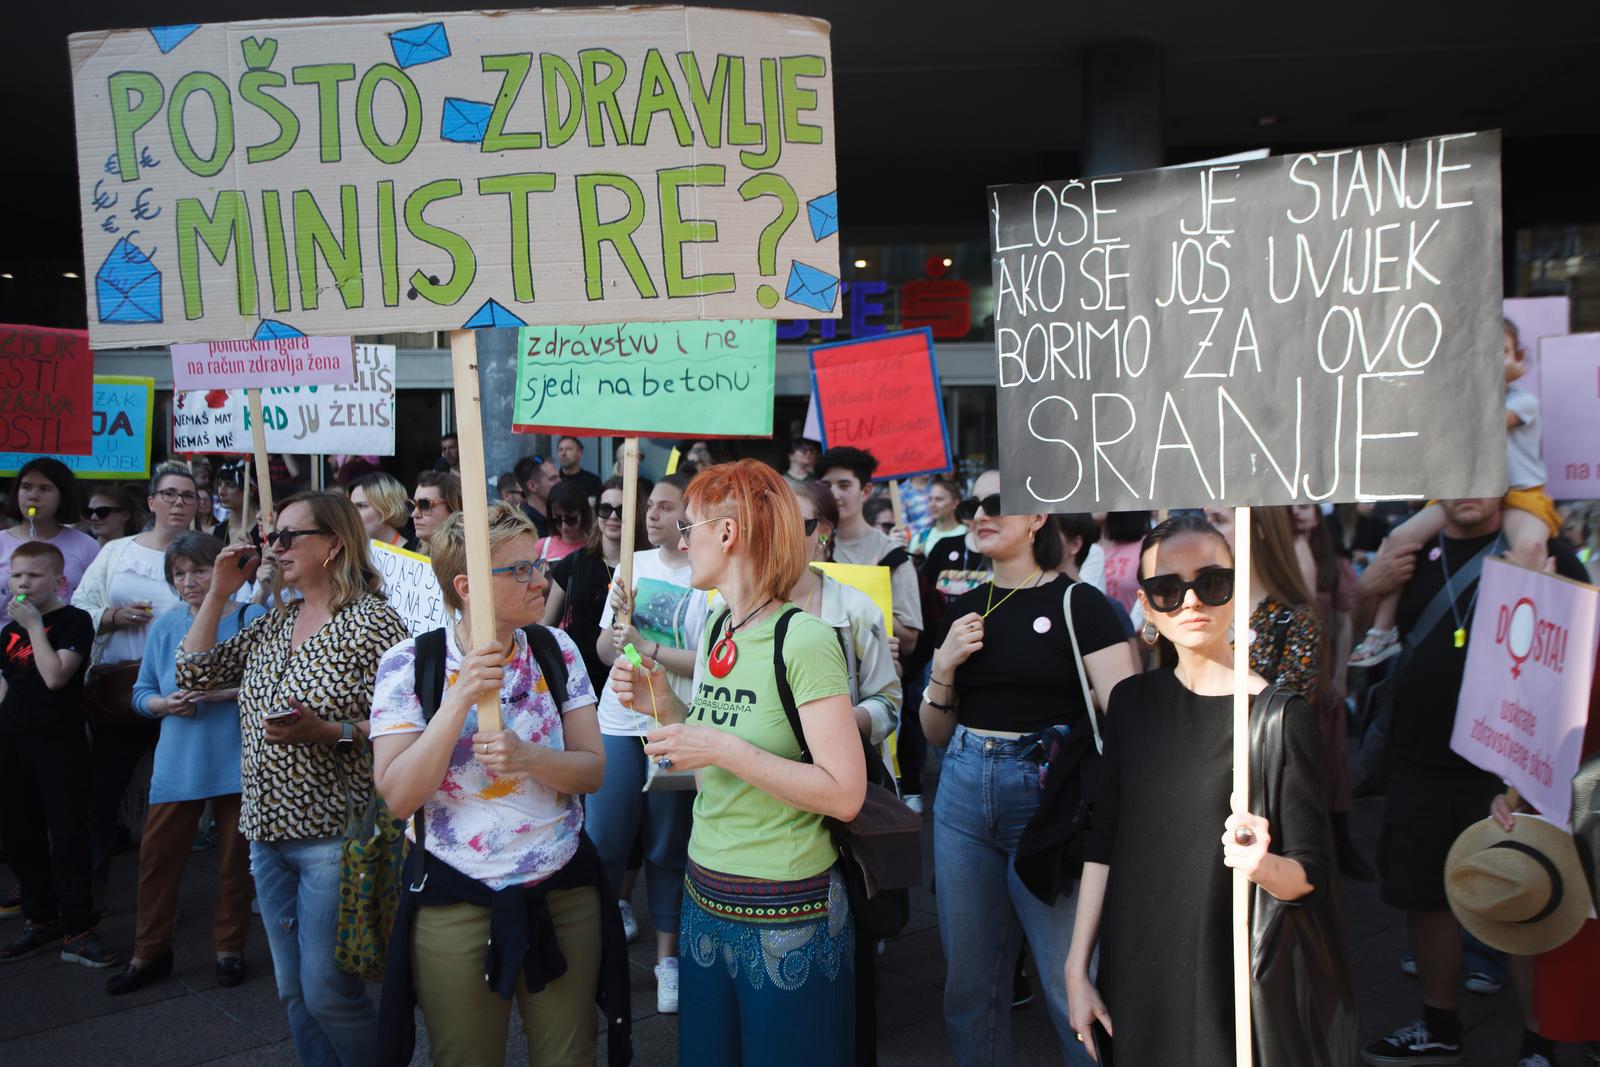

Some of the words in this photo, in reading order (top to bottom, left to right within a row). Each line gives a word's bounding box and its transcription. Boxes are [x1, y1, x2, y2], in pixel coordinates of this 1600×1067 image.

[108, 36, 423, 183] POŠTO
[481, 48, 827, 170] ZDRAVLJE
[991, 177, 1123, 252] LOŠE
[1179, 164, 1241, 236] JE
[1286, 132, 1478, 224] STANJE
[176, 164, 800, 321] MINISTRE?
[995, 250, 1066, 321] AKO
[1079, 243, 1131, 311] SE
[1155, 234, 1232, 308] JOŠ
[1267, 218, 1442, 304] UVIJEK
[187, 361, 204, 375] na
[207, 356, 245, 375] račun
[249, 354, 303, 376] zdravlja
[308, 353, 340, 371] žena
[676, 329, 689, 355] i
[704, 329, 740, 352] ne
[997, 314, 1151, 388] BORIMO
[1183, 307, 1262, 379] ZA
[1316, 302, 1443, 374] OVO
[174, 411, 209, 428] NEMAŠ
[521, 367, 581, 420] sjedi
[598, 377, 633, 397] na
[174, 431, 210, 449] NEMAŠ
[243, 405, 289, 431] KAD
[293, 404, 320, 440] JU
[1026, 370, 1425, 502] SRANJE
[95, 455, 142, 470] VIJEK
